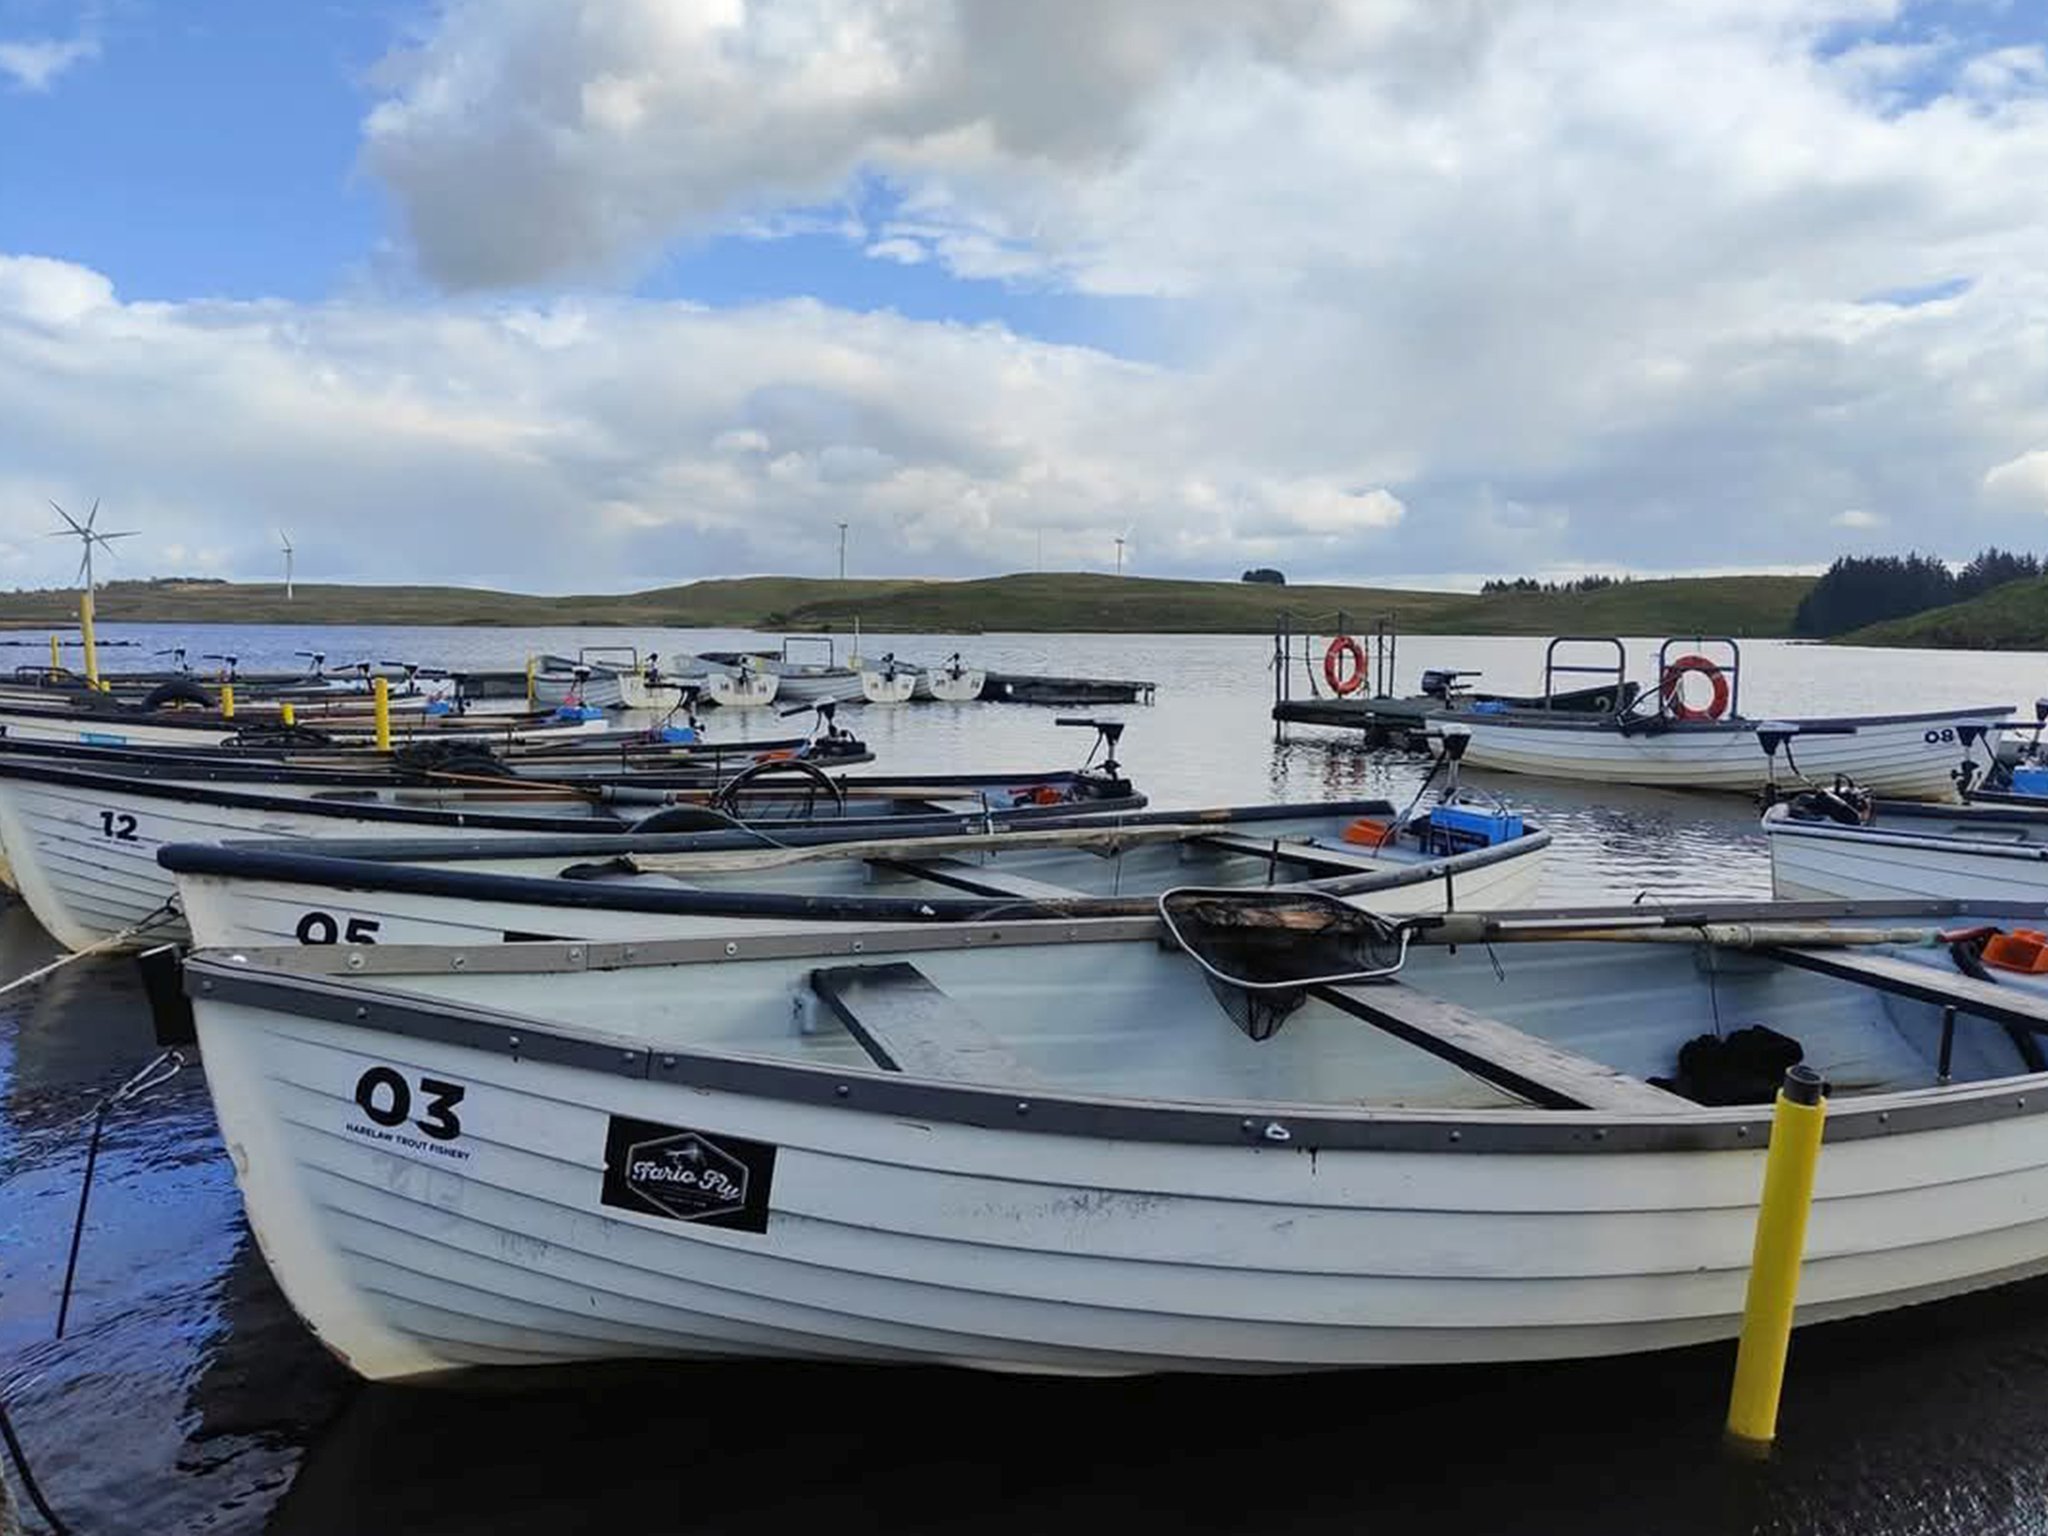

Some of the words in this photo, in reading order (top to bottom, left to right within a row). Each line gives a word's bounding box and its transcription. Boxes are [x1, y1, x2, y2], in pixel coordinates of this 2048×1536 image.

[1925, 728, 1954, 744] 08
[100, 811, 138, 842] 12
[356, 1066, 465, 1141] 03
[346, 1123, 393, 1142] HARELAW
[396, 1135, 428, 1152] TROUT
[429, 1143, 471, 1161] FISHERY
[632, 1160, 697, 1184] Fario
[698, 1168, 742, 1201] Fly
